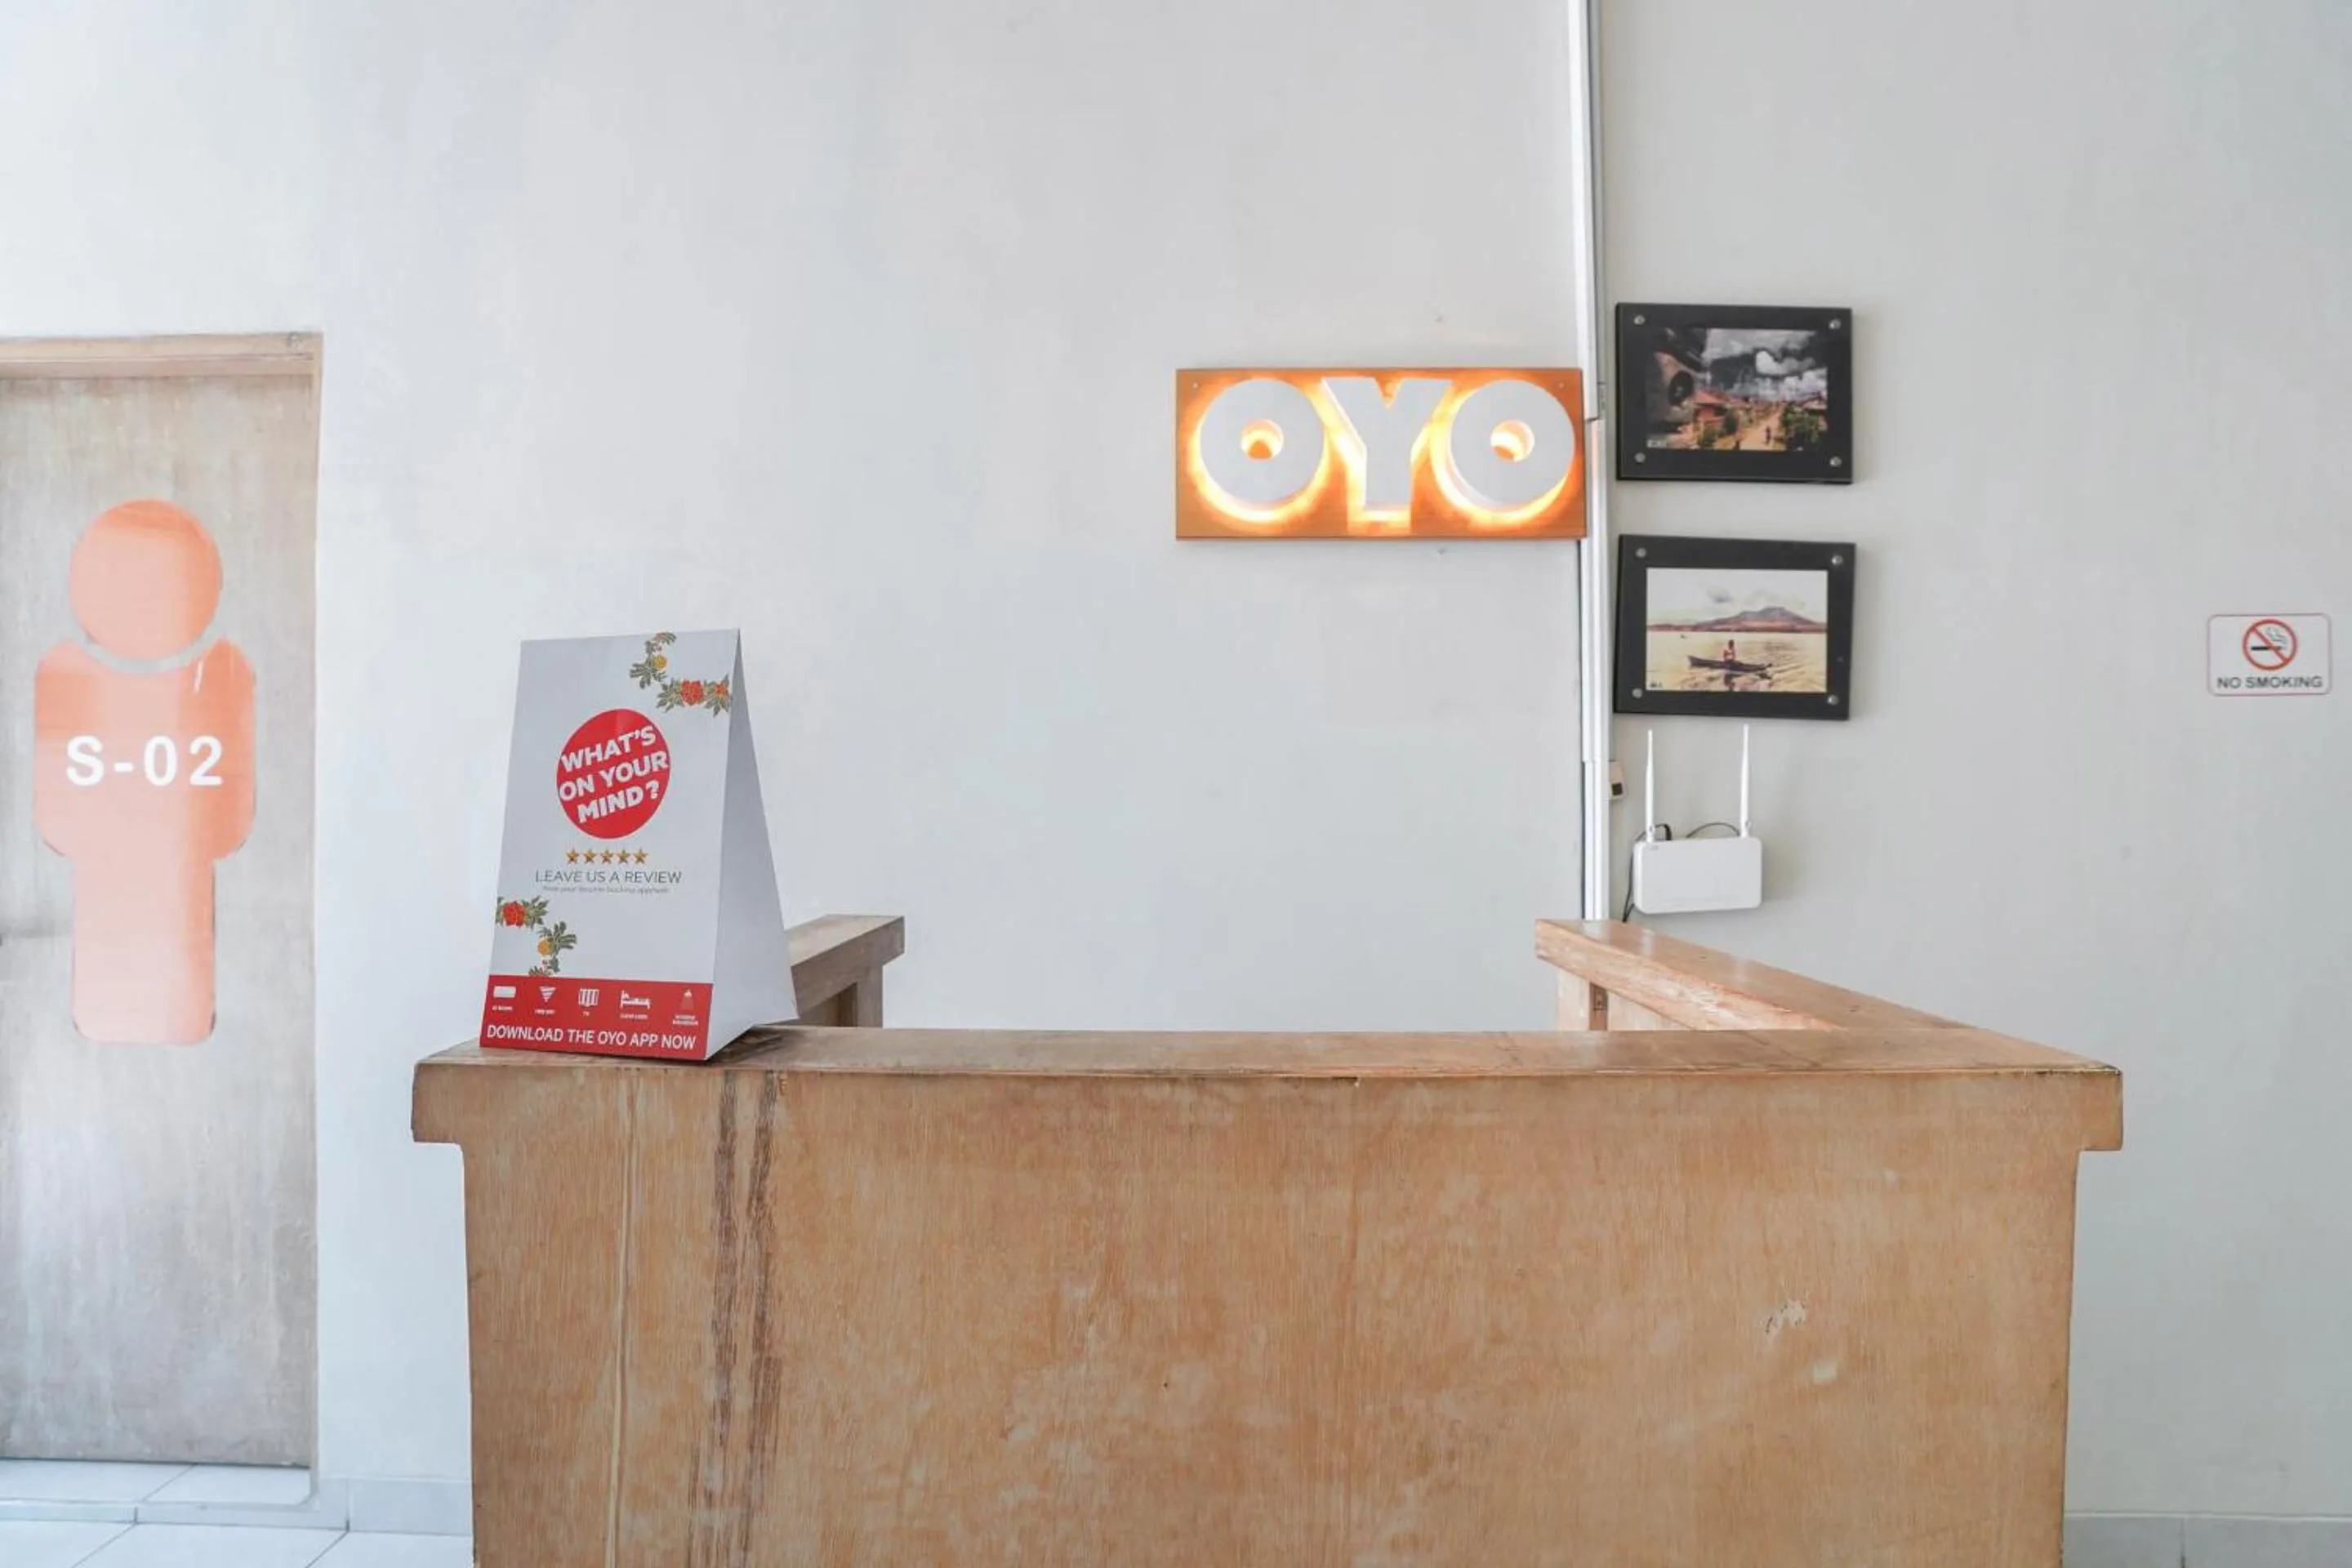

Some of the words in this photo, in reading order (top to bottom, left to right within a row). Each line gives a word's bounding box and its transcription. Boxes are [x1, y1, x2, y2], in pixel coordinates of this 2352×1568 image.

[1199, 376, 1576, 506] OYO
[2217, 676, 2241, 688] NO
[2246, 675, 2323, 688] SMOKING
[66, 735, 222, 786] S-02
[561, 725, 656, 773] WHAT'S
[559, 774, 595, 801] ON
[599, 751, 669, 787] YOUR
[536, 870, 581, 883] LEAVE
[586, 871, 606, 883] US
[608, 872, 620, 883] A
[625, 871, 682, 884] REVIEW
[487, 1024, 564, 1042] DOWNLOAD
[568, 1029, 595, 1044] THE
[598, 1031, 626, 1045] OYO
[630, 1032, 658, 1047] APP
[662, 1034, 697, 1049] NOW
